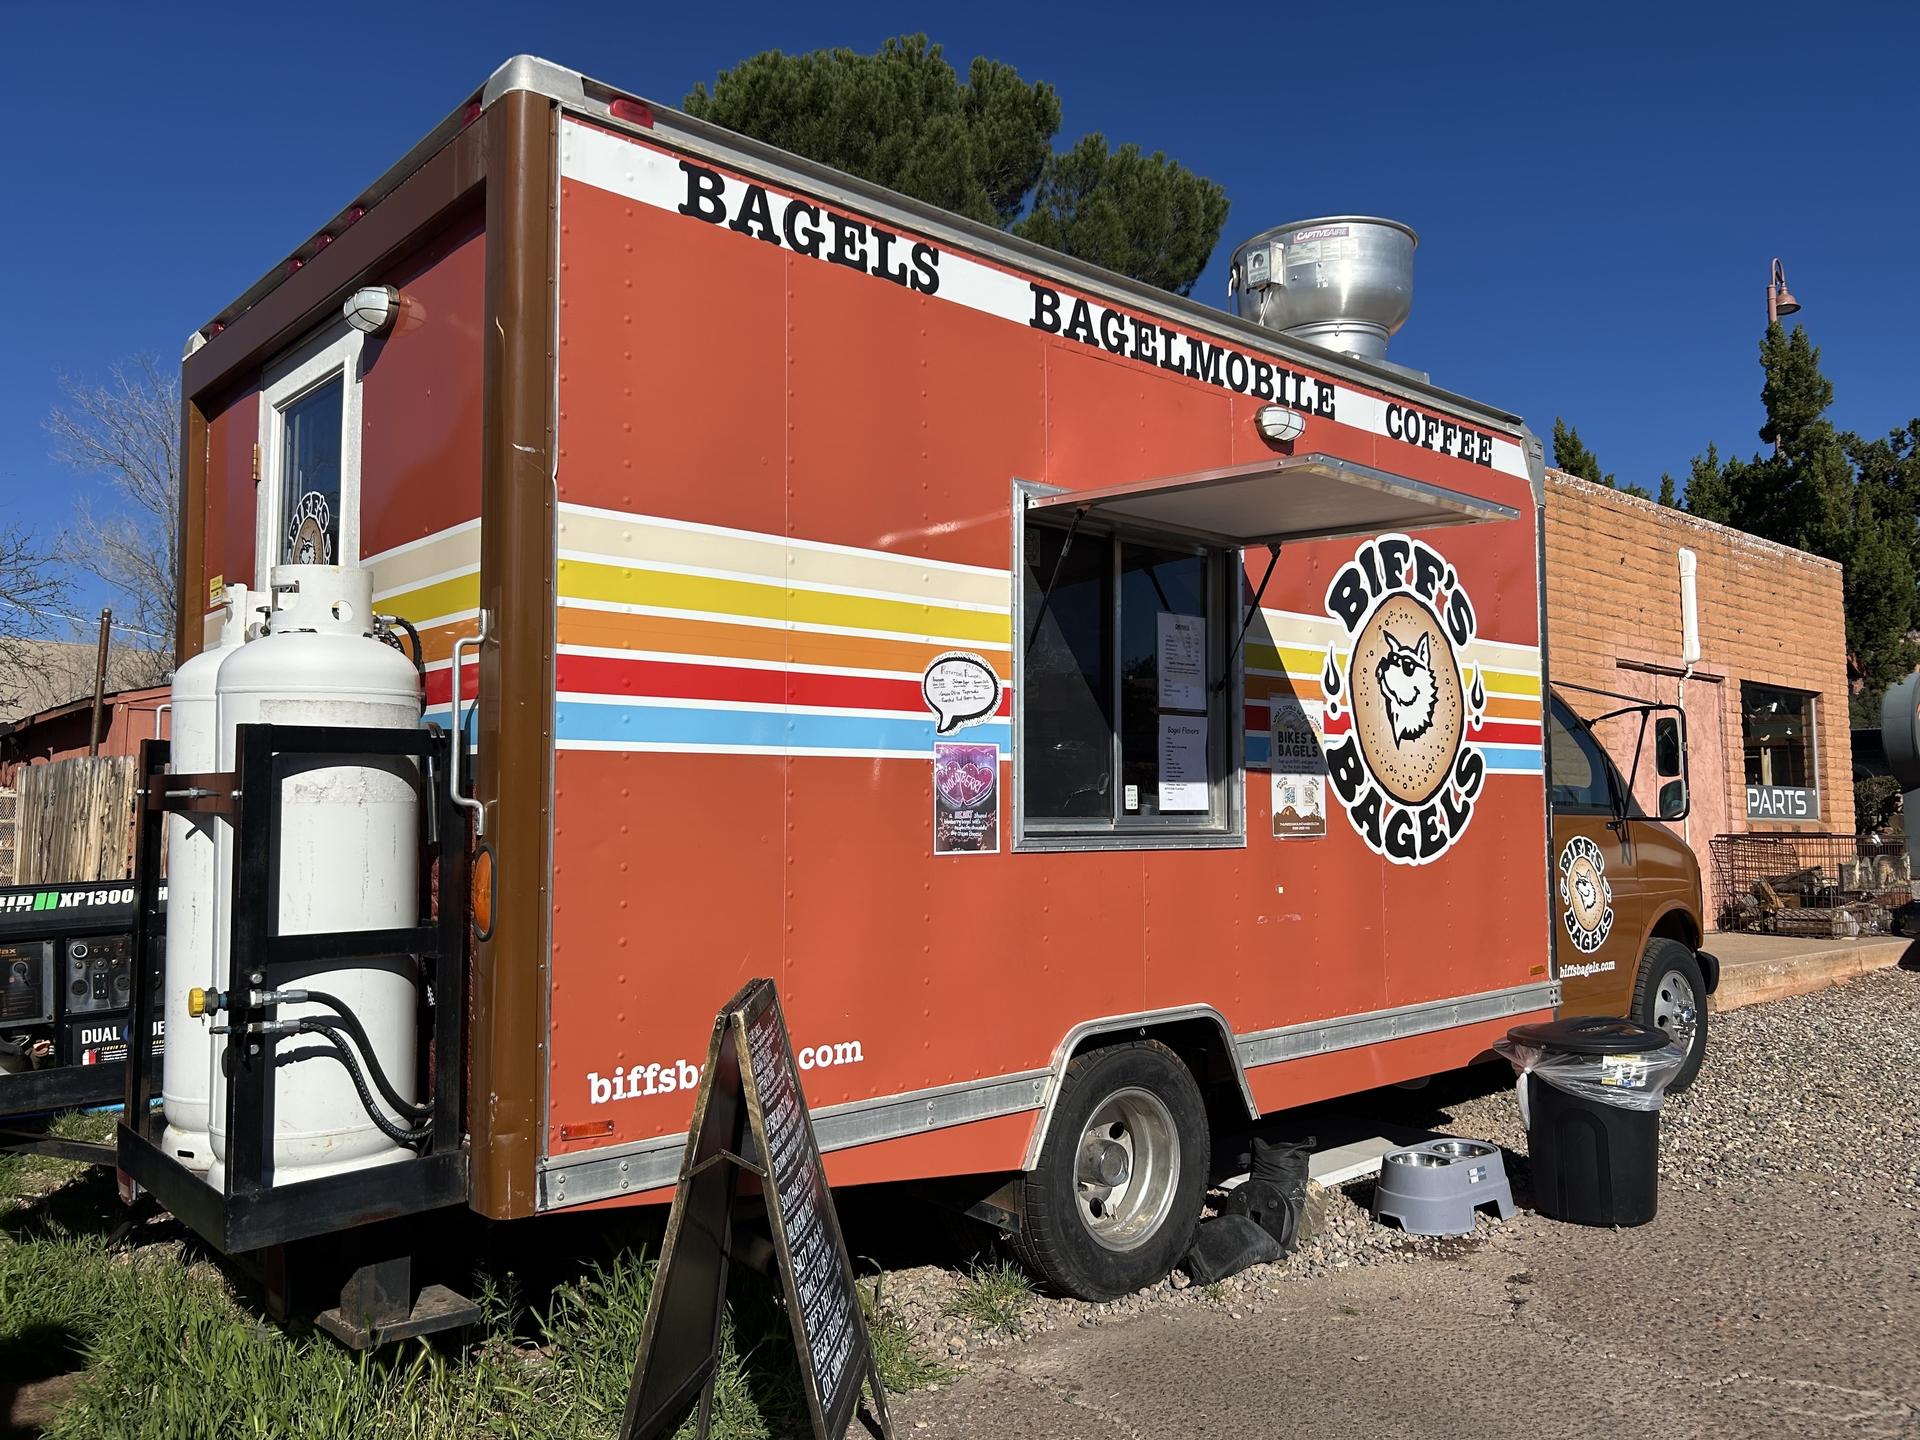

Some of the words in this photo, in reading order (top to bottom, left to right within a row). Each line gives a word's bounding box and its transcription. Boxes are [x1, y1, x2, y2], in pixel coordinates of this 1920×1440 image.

[678, 160, 940, 295] BAGELS
[1029, 282, 1335, 421] BAGELMOBILE
[1386, 402, 1493, 467] COFFEE
[1328, 539, 1474, 647] BIFF'S
[1278, 730, 1307, 744] BIKES
[1278, 743, 1319, 758] BAGELS
[1325, 735, 1485, 860] BAGELS
[1747, 788, 1807, 816] PARTS
[1560, 837, 1604, 873] BIFF'S
[1565, 908, 1614, 951] BAGELS
[1559, 960, 1616, 979] biffsbagels.com
[81, 1026, 121, 1045] DUAL
[798, 1262, 819, 1313] TURKEY
